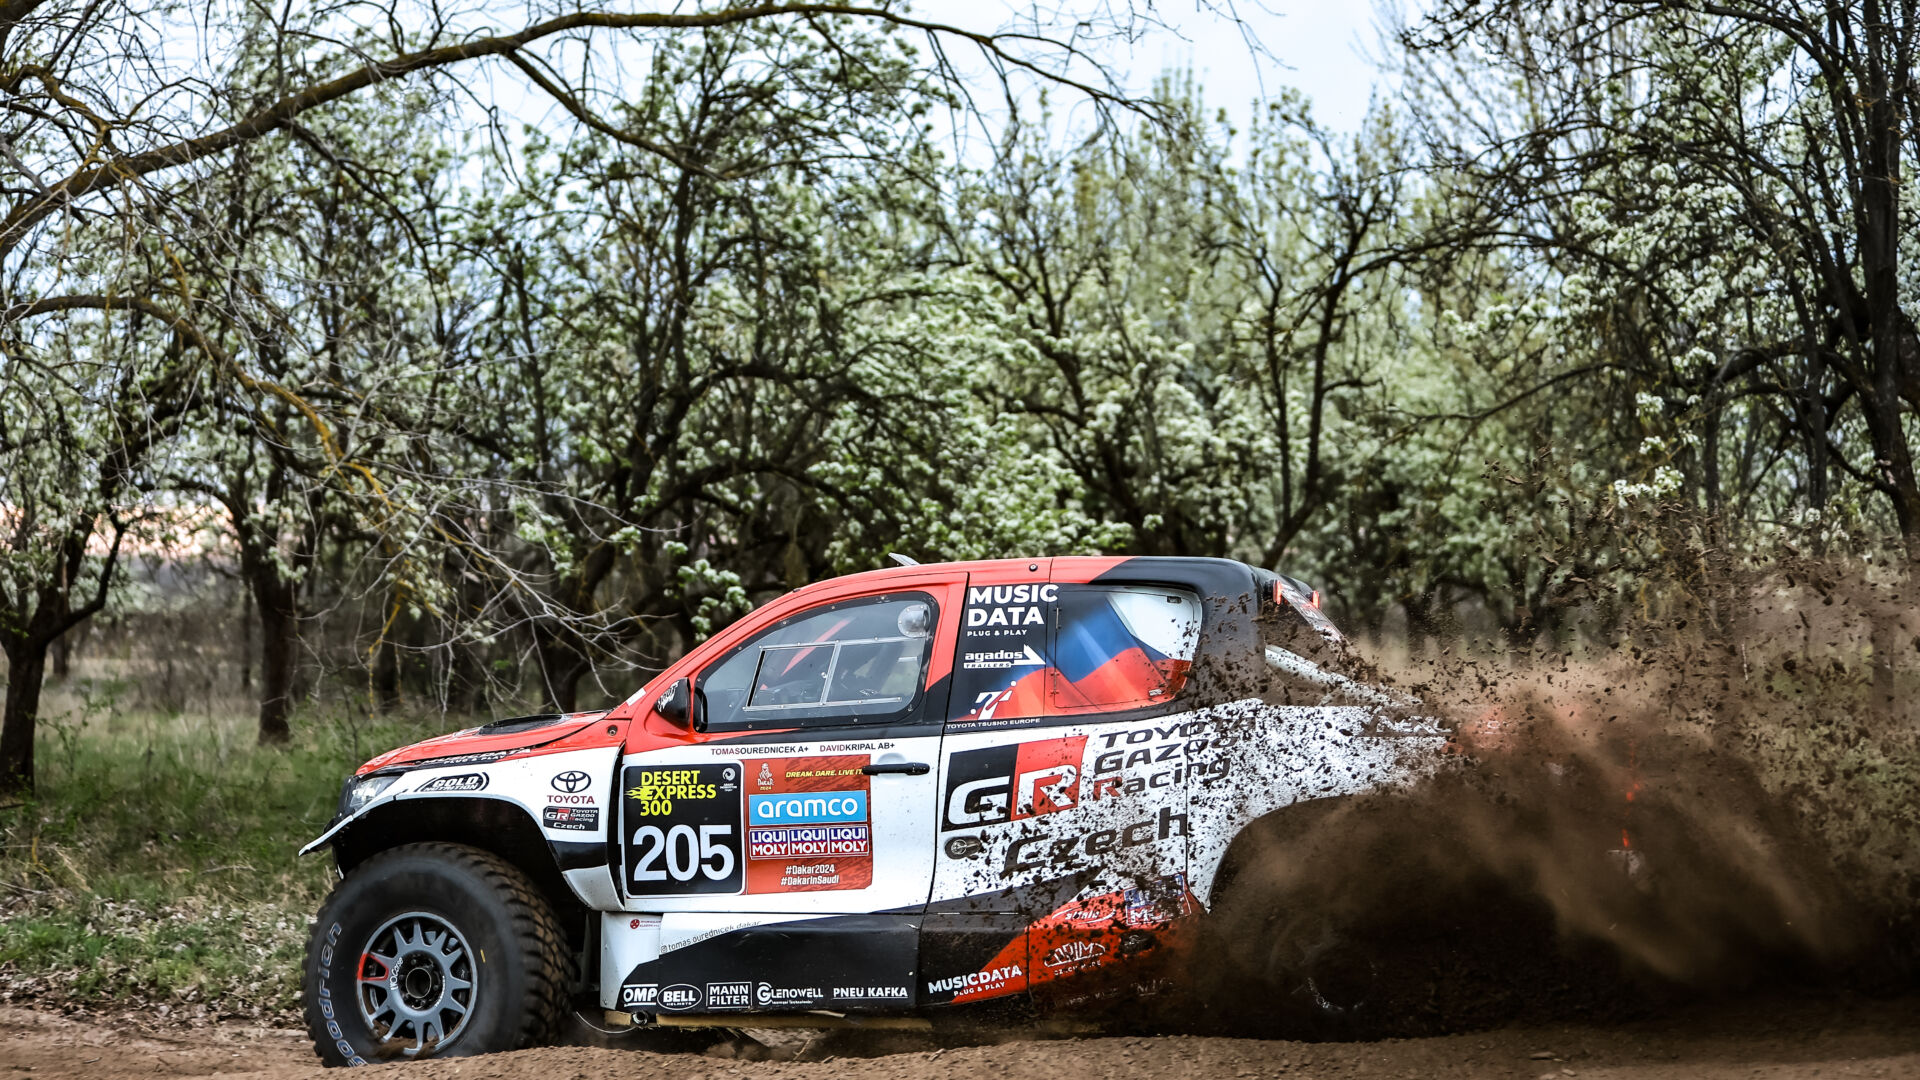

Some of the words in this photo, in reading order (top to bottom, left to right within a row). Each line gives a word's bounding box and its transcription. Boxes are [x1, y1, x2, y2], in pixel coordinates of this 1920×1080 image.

[969, 584, 1059, 604] MUSIC
[967, 606, 1044, 627] DATA
[965, 650, 1023, 662] agados
[878, 742, 895, 750] AB+
[641, 770, 700, 786] DESERT
[785, 770, 814, 778] DREAM.
[815, 769, 837, 777] DARE.
[1093, 758, 1232, 801] Racing
[432, 776, 479, 787] GOLD
[640, 784, 717, 800] EXPRESS
[948, 764, 1076, 825] GR
[547, 795, 595, 804] TOYOTA
[640, 799, 672, 816] 300
[757, 798, 858, 818] aramco
[546, 811, 569, 820] GR
[751, 831, 786, 843] LIQUI
[791, 829, 826, 842] LIQUI
[831, 828, 866, 840] LIQUI
[831, 841, 867, 853] MOLY
[1001, 806, 1188, 876] Czech
[633, 824, 735, 881] 205
[752, 844, 787, 856] MOLY
[791, 842, 827, 854] MOLY
[785, 864, 835, 875] #Dakar2024
[780, 874, 839, 886] #DakarInSaudi
[928, 964, 1023, 994] MUSICDATA
[709, 985, 749, 996] MANN
[833, 987, 863, 997] PNEU
[868, 987, 908, 997] KAFKA
[953, 988, 975, 996] PLUG
[985, 981, 1006, 991] PLAY
[623, 987, 658, 1003] OMP
[663, 990, 696, 1003] BELL
[709, 995, 749, 1005] FILTER
